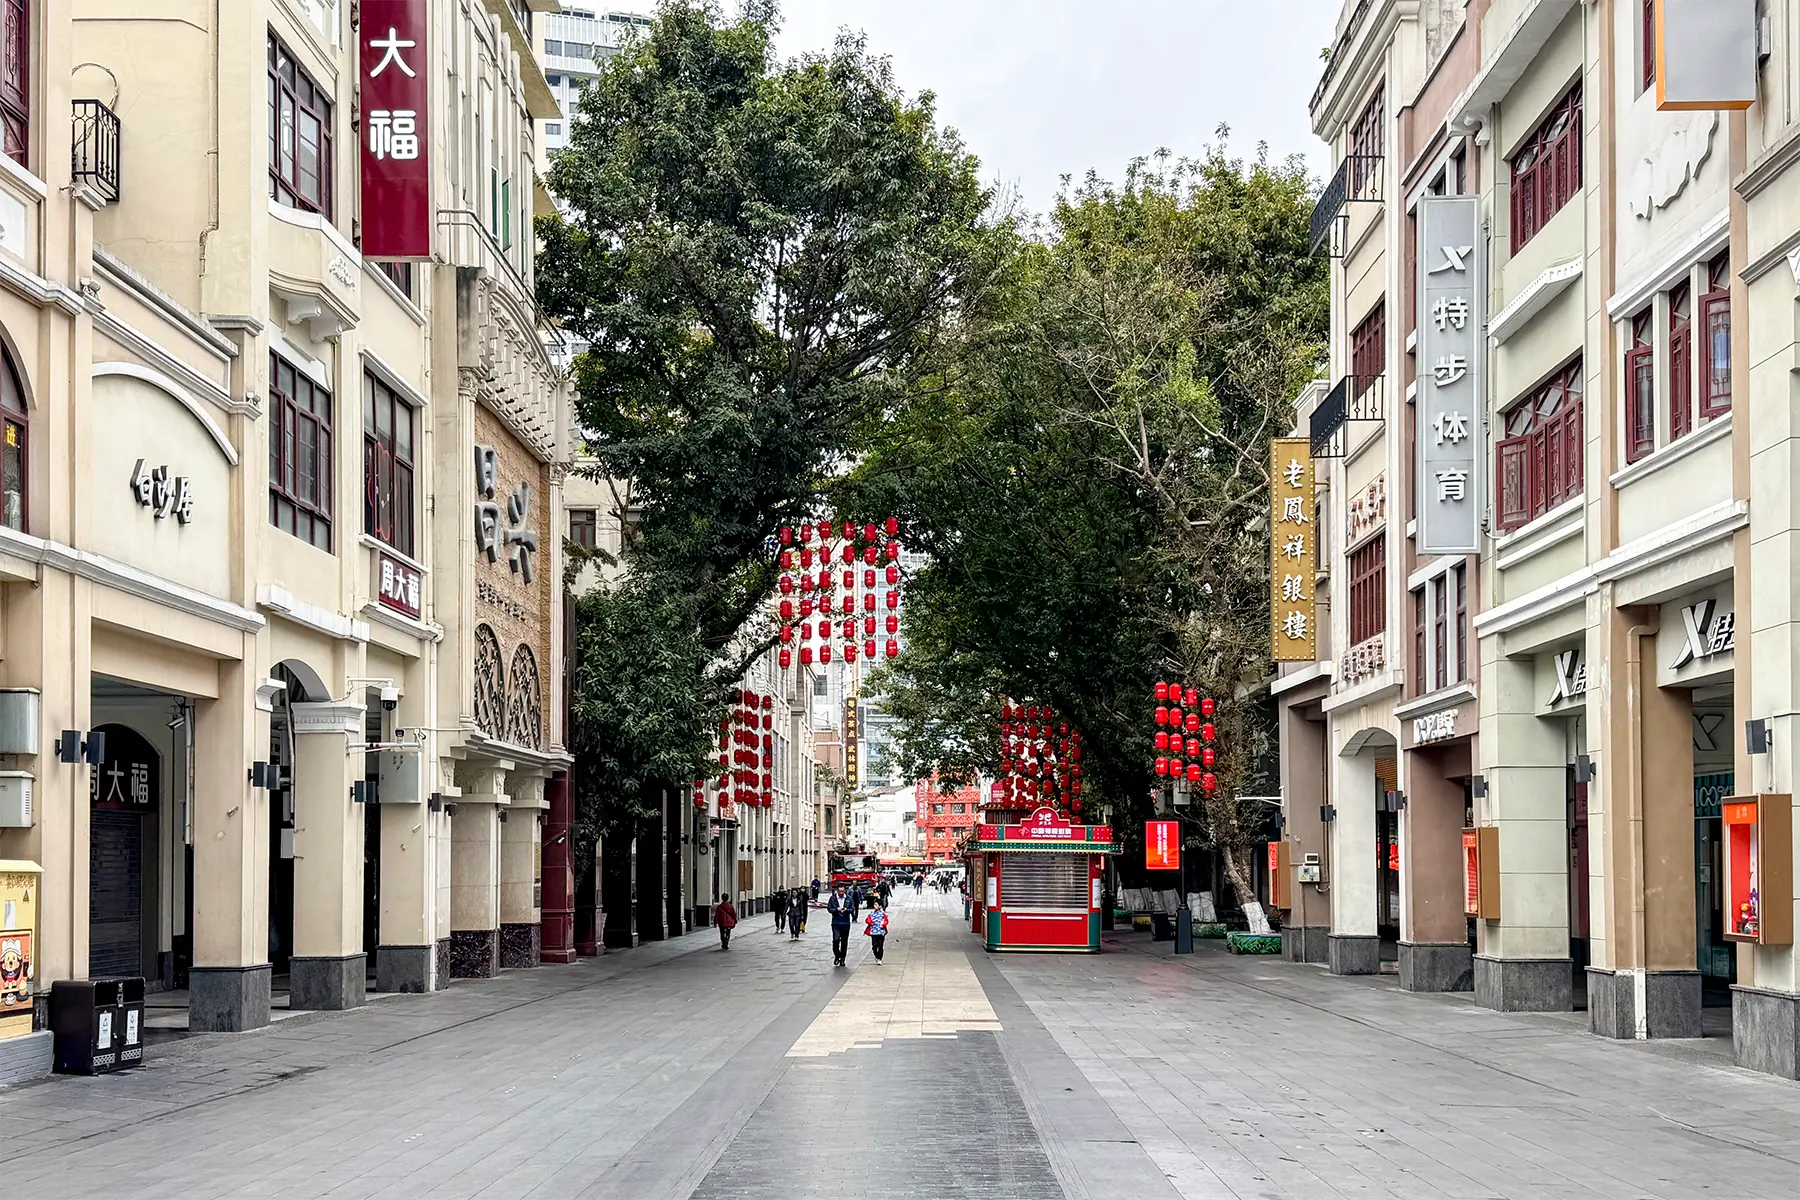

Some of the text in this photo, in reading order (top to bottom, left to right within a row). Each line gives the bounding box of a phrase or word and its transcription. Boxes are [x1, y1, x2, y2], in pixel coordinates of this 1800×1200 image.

[369, 27, 419, 160] 大福
[1432, 296, 1469, 502] 特步体育
[381, 559, 419, 610] 周大福
[1280, 458, 1309, 641] 老鳳祥銀樓
